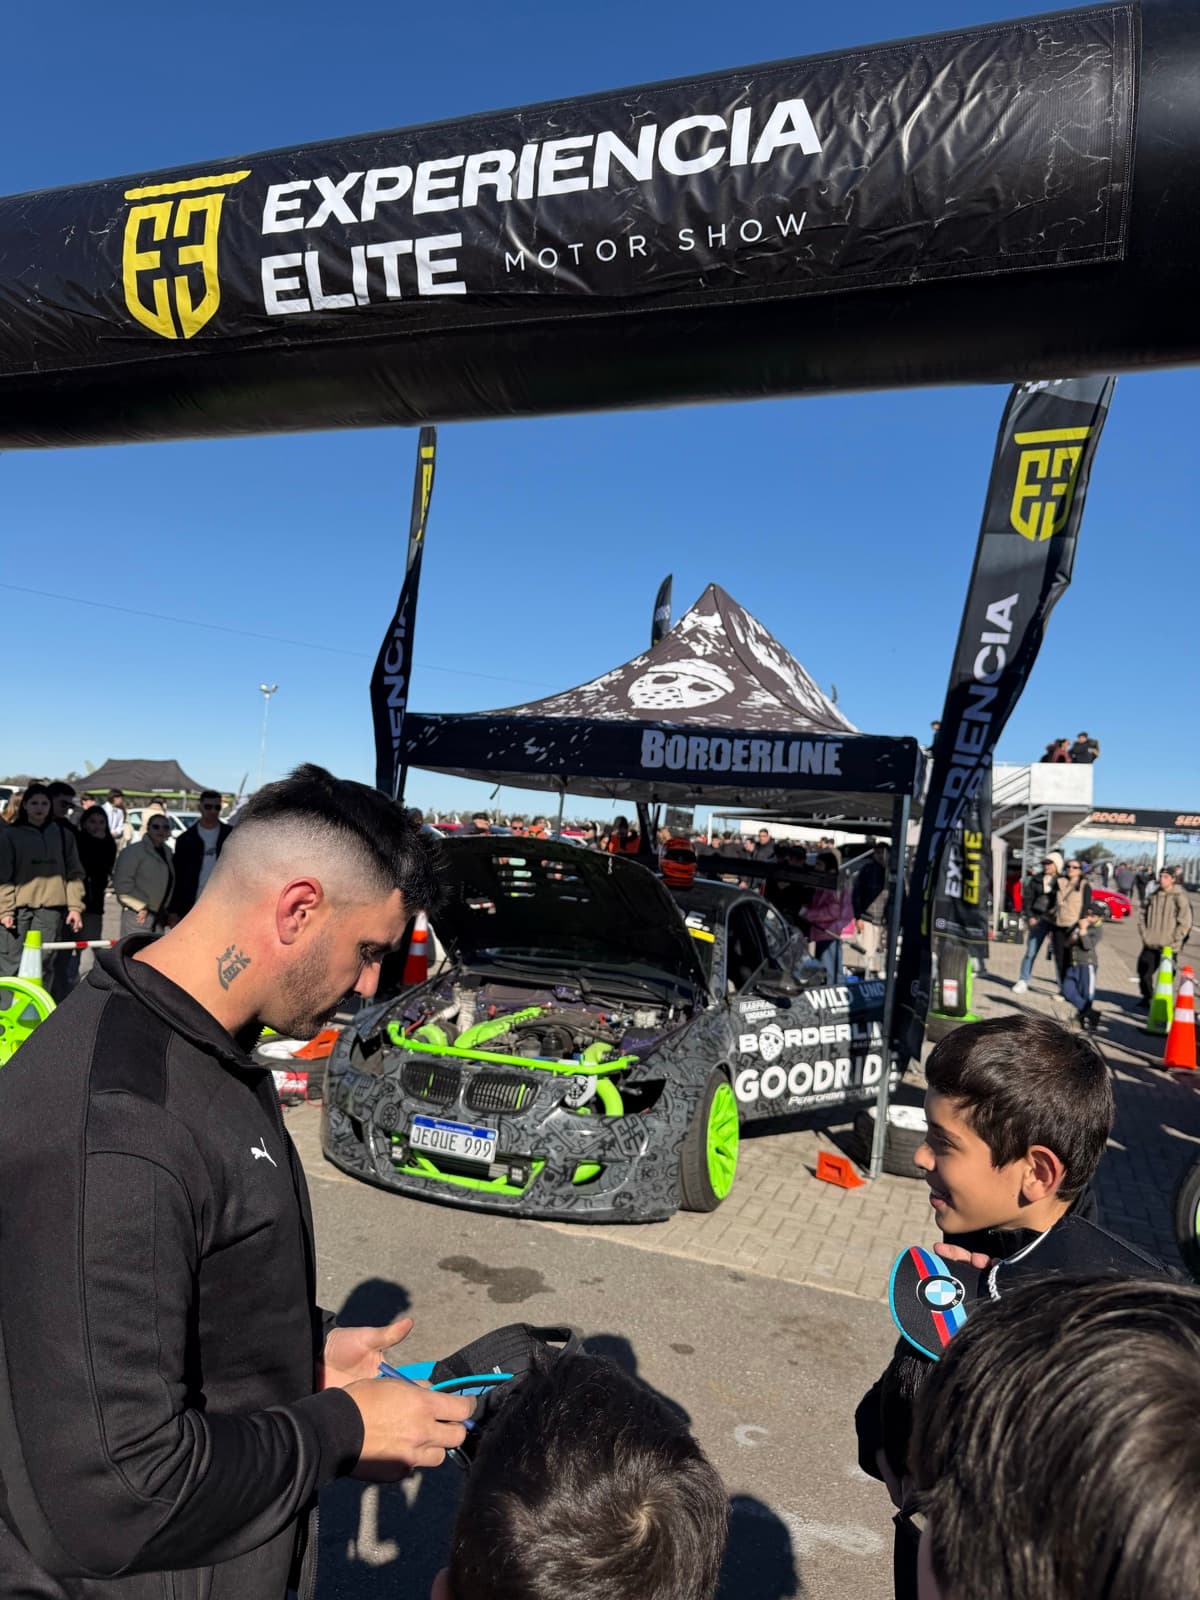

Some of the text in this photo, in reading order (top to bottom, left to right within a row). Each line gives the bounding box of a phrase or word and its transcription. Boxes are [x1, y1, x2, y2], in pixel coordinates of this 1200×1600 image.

[262, 98, 823, 235] EXPERIENCIA
[505, 211, 807, 273] MOTOR SHOW
[261, 232, 467, 315] ELITE
[640, 729, 843, 776] BORDERLINE
[962, 829, 983, 904] ELITE
[735, 1053, 898, 1103] GOODRID
[412, 1127, 458, 1152] JEQUE
[464, 1137, 492, 1158] 999
